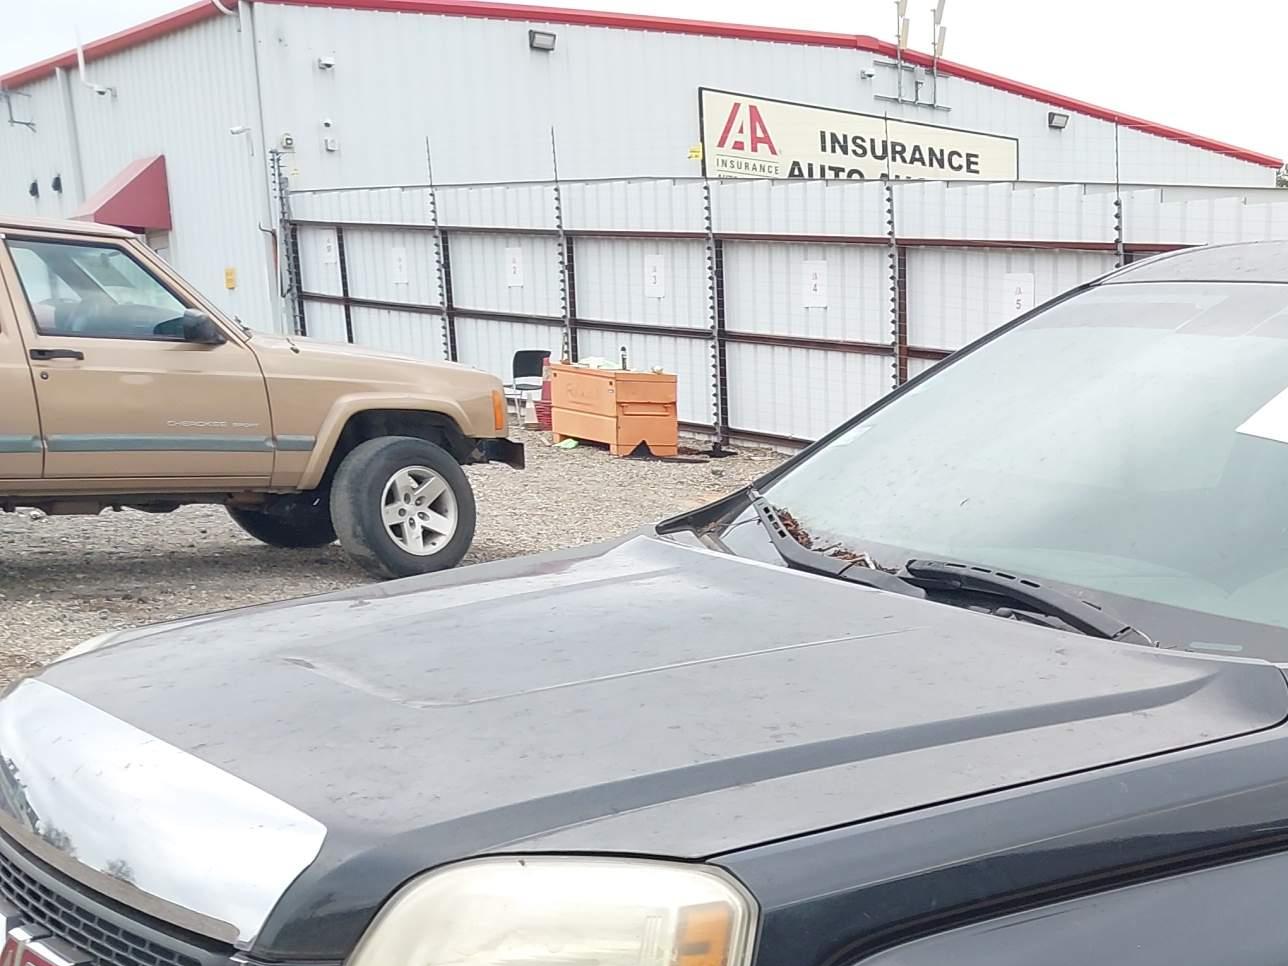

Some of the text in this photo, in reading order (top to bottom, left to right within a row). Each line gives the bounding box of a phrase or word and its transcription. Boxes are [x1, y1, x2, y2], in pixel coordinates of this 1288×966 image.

[819, 130, 980, 175] INSURANCE
[716, 158, 780, 175] INSURANCE
[1015, 298, 1022, 310] 5
